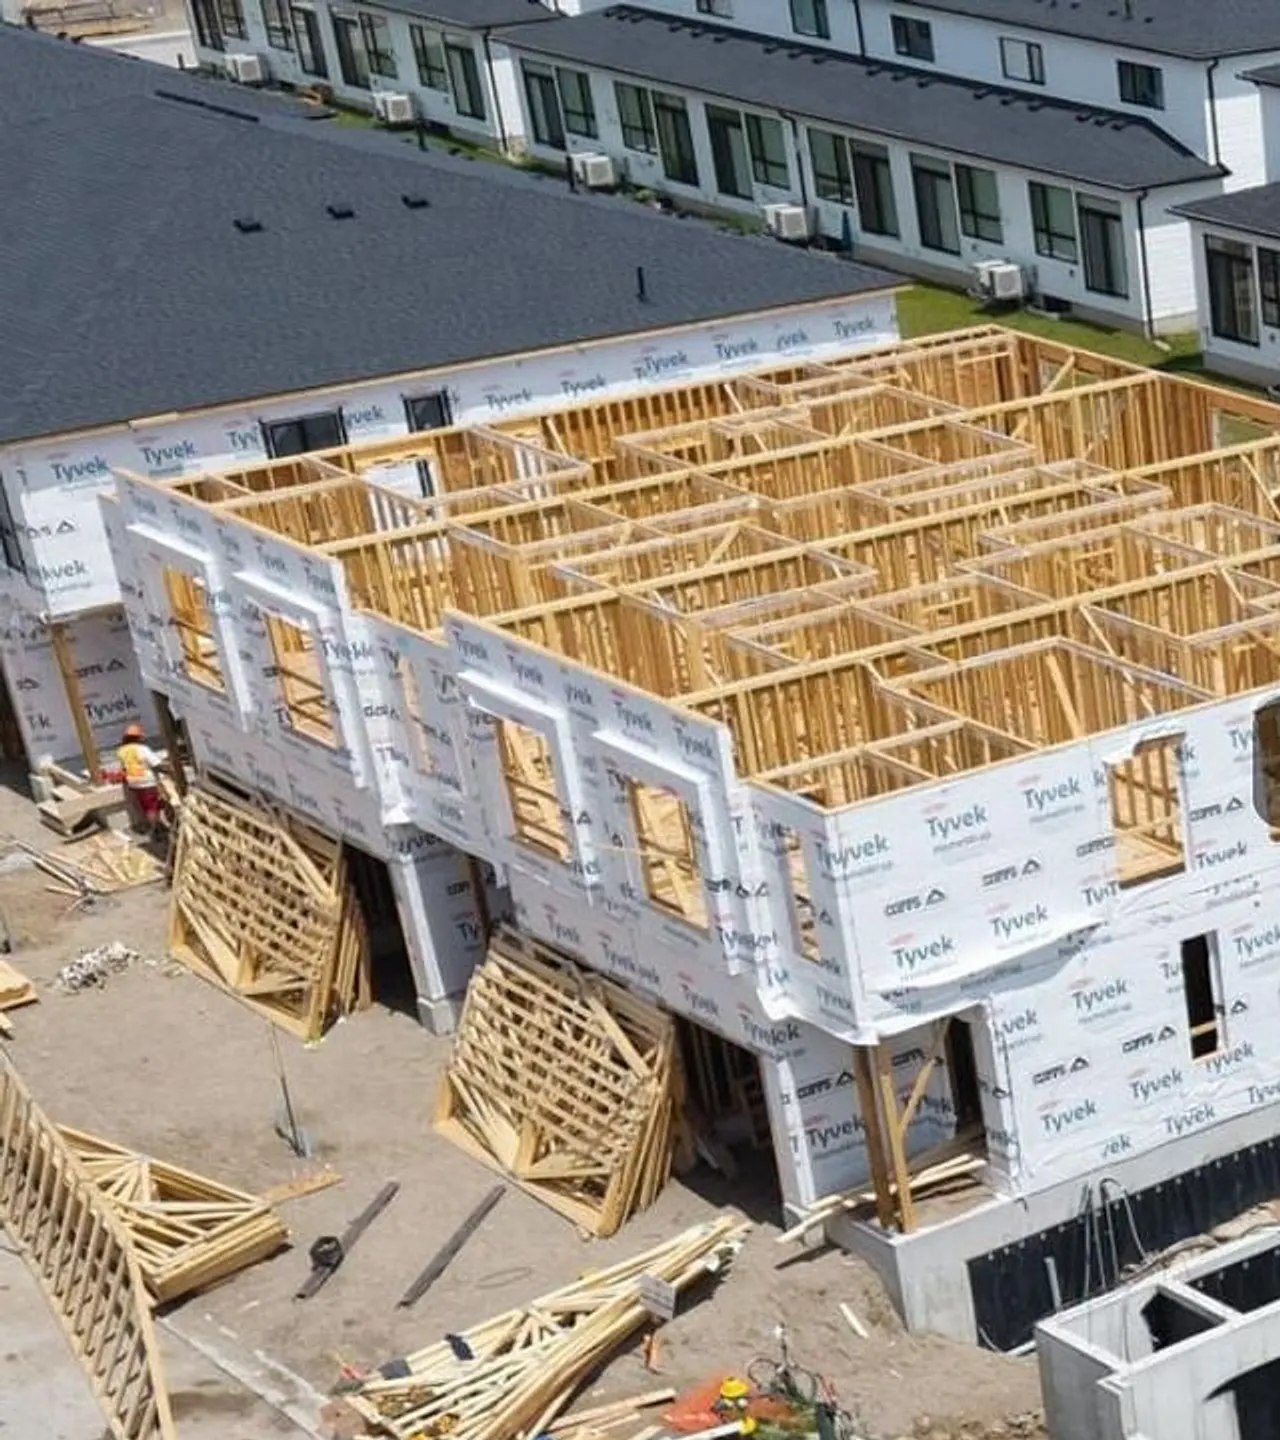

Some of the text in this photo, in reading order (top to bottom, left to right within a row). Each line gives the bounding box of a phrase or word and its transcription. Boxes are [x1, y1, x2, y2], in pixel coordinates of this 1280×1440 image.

[832, 315, 877, 340] Tyvek
[713, 336, 760, 361] Tyvek
[140, 440, 196, 466] Tyvek
[1022, 776, 1082, 809] Tyvek
[925, 804, 989, 839] Tyvek
[989, 904, 1048, 939] Tyvek
[893, 934, 955, 971] Tyvek
[1072, 979, 1128, 1012] Tyvek
[1129, 1068, 1184, 1102] Tyvek
[804, 1114, 867, 1150] Tyvek
[1040, 1100, 1097, 1132] Tyvek
[1164, 1103, 1216, 1135] Tyvek
